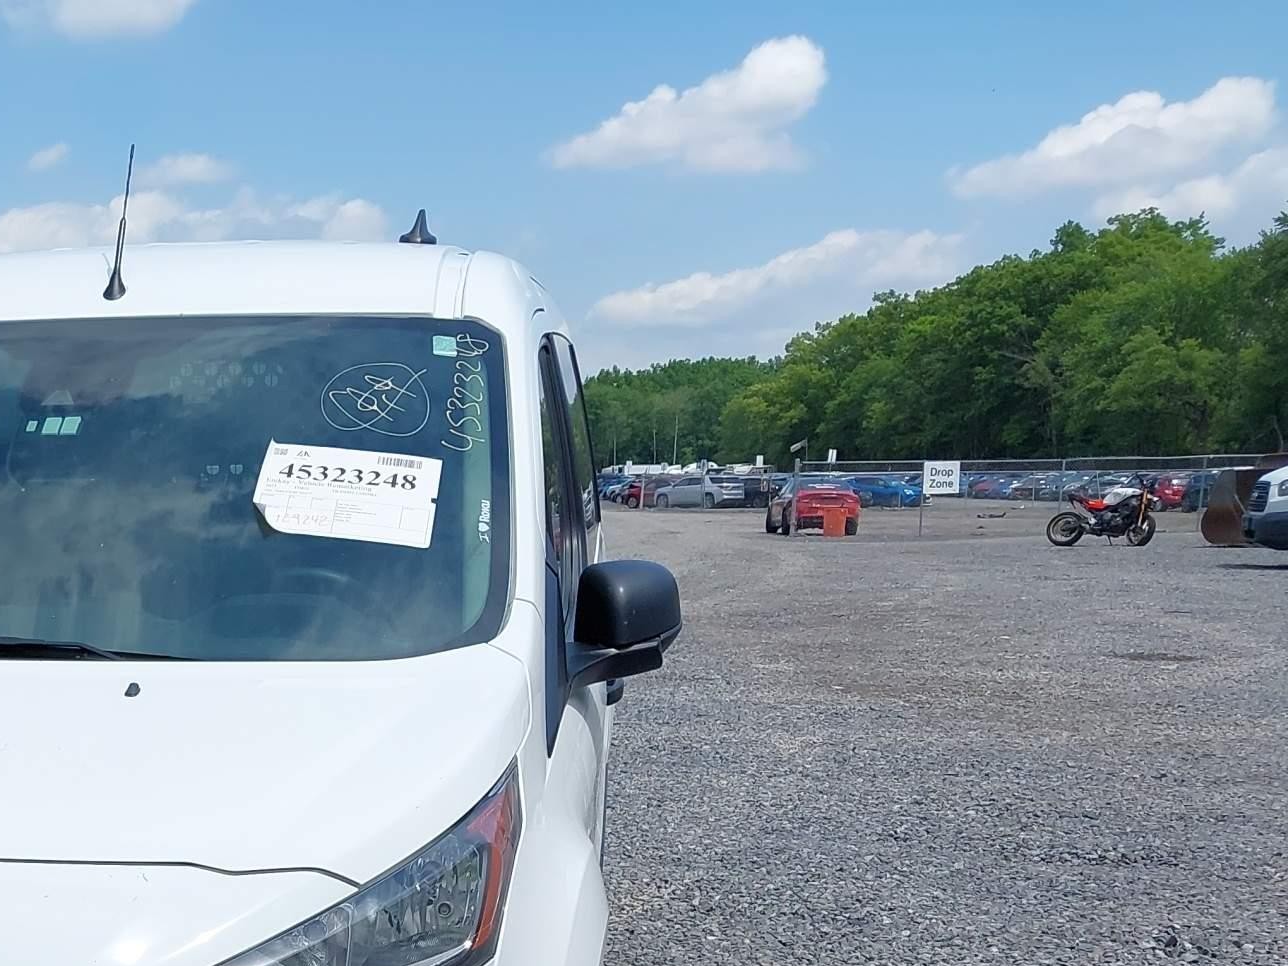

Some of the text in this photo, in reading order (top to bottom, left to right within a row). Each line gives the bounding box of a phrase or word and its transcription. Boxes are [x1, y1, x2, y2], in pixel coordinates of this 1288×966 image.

[279, 463, 417, 490] 45323248
[930, 467, 954, 478] Drop
[929, 478, 954, 488] Zone
